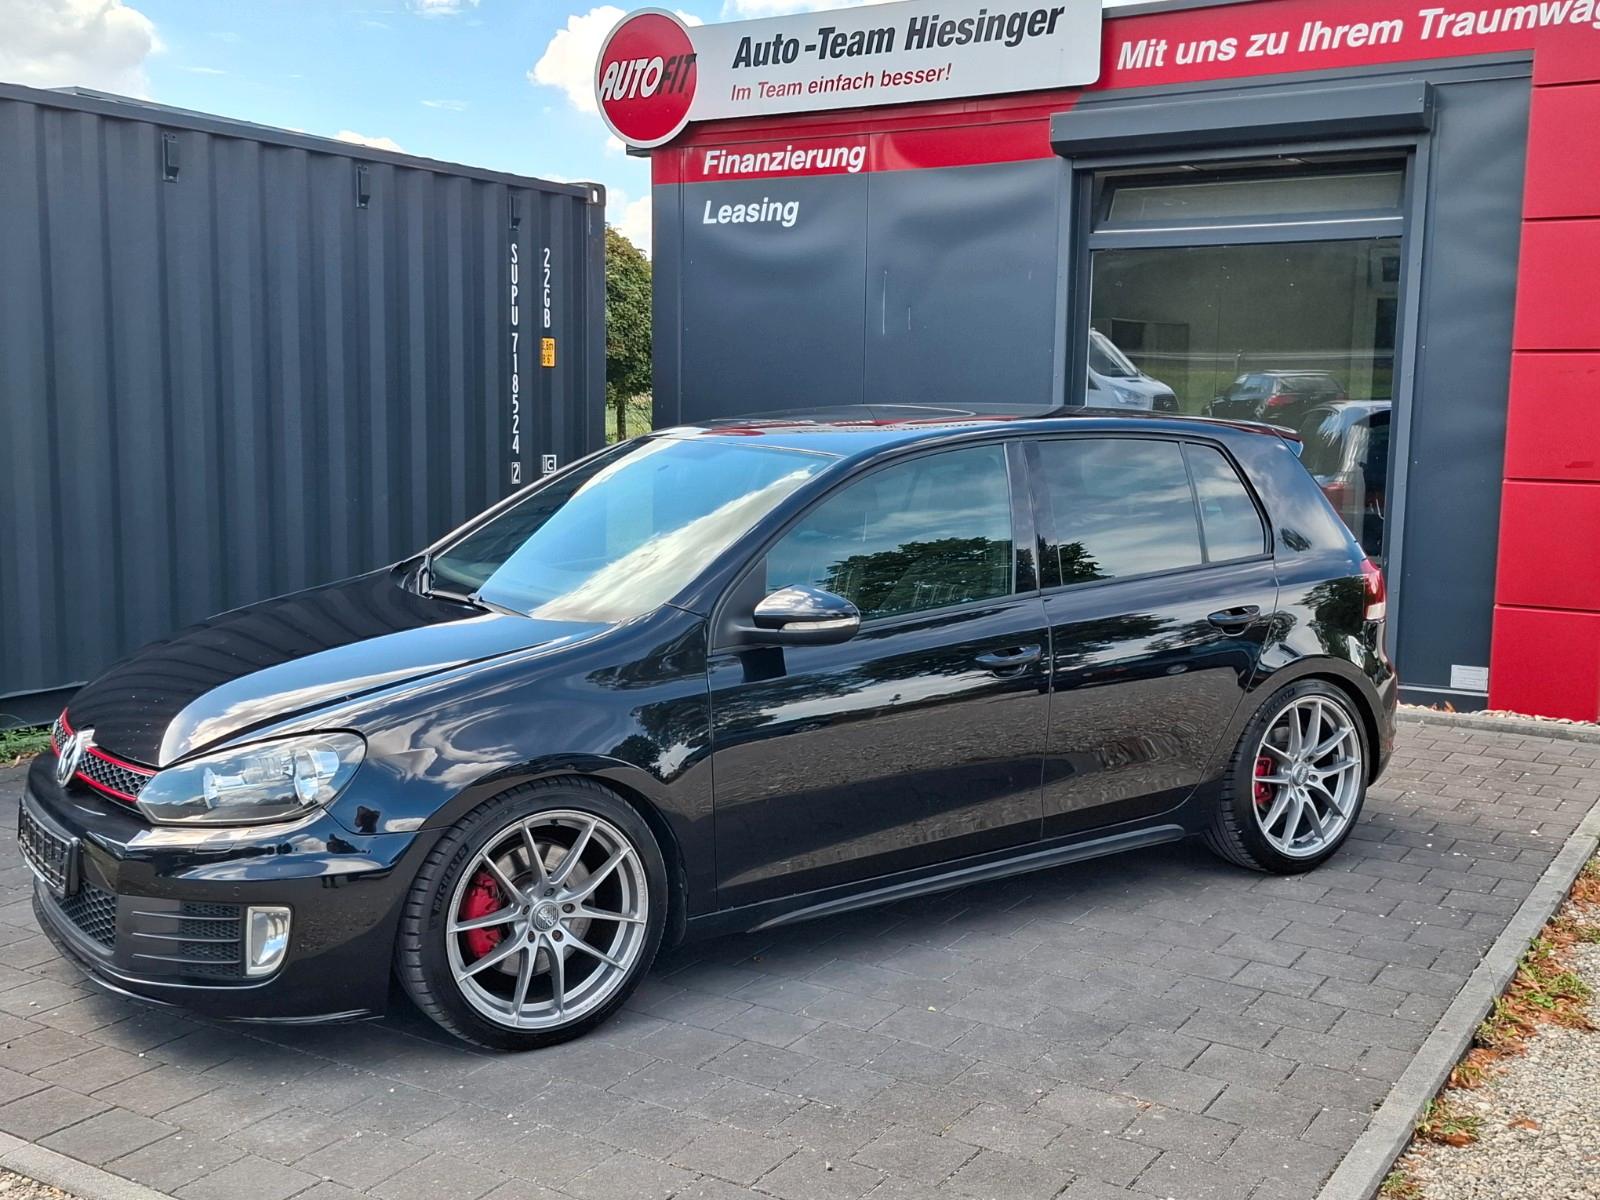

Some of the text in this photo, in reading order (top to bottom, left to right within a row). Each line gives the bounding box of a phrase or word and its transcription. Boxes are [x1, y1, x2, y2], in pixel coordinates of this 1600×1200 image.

[904, 7, 1066, 51] Hiesinger
[1117, 38, 1168, 71] Mit
[1176, 37, 1238, 65] uns
[1246, 31, 1290, 58] zu
[1298, 19, 1404, 53] Ihrem
[731, 63, 952, 101] Im Team einfach besser!
[703, 145, 867, 175] Finanzierung
[703, 197, 800, 228] Leasing
[543, 247, 551, 329] 22GB
[511, 243, 520, 484] SUPU 718524 2
